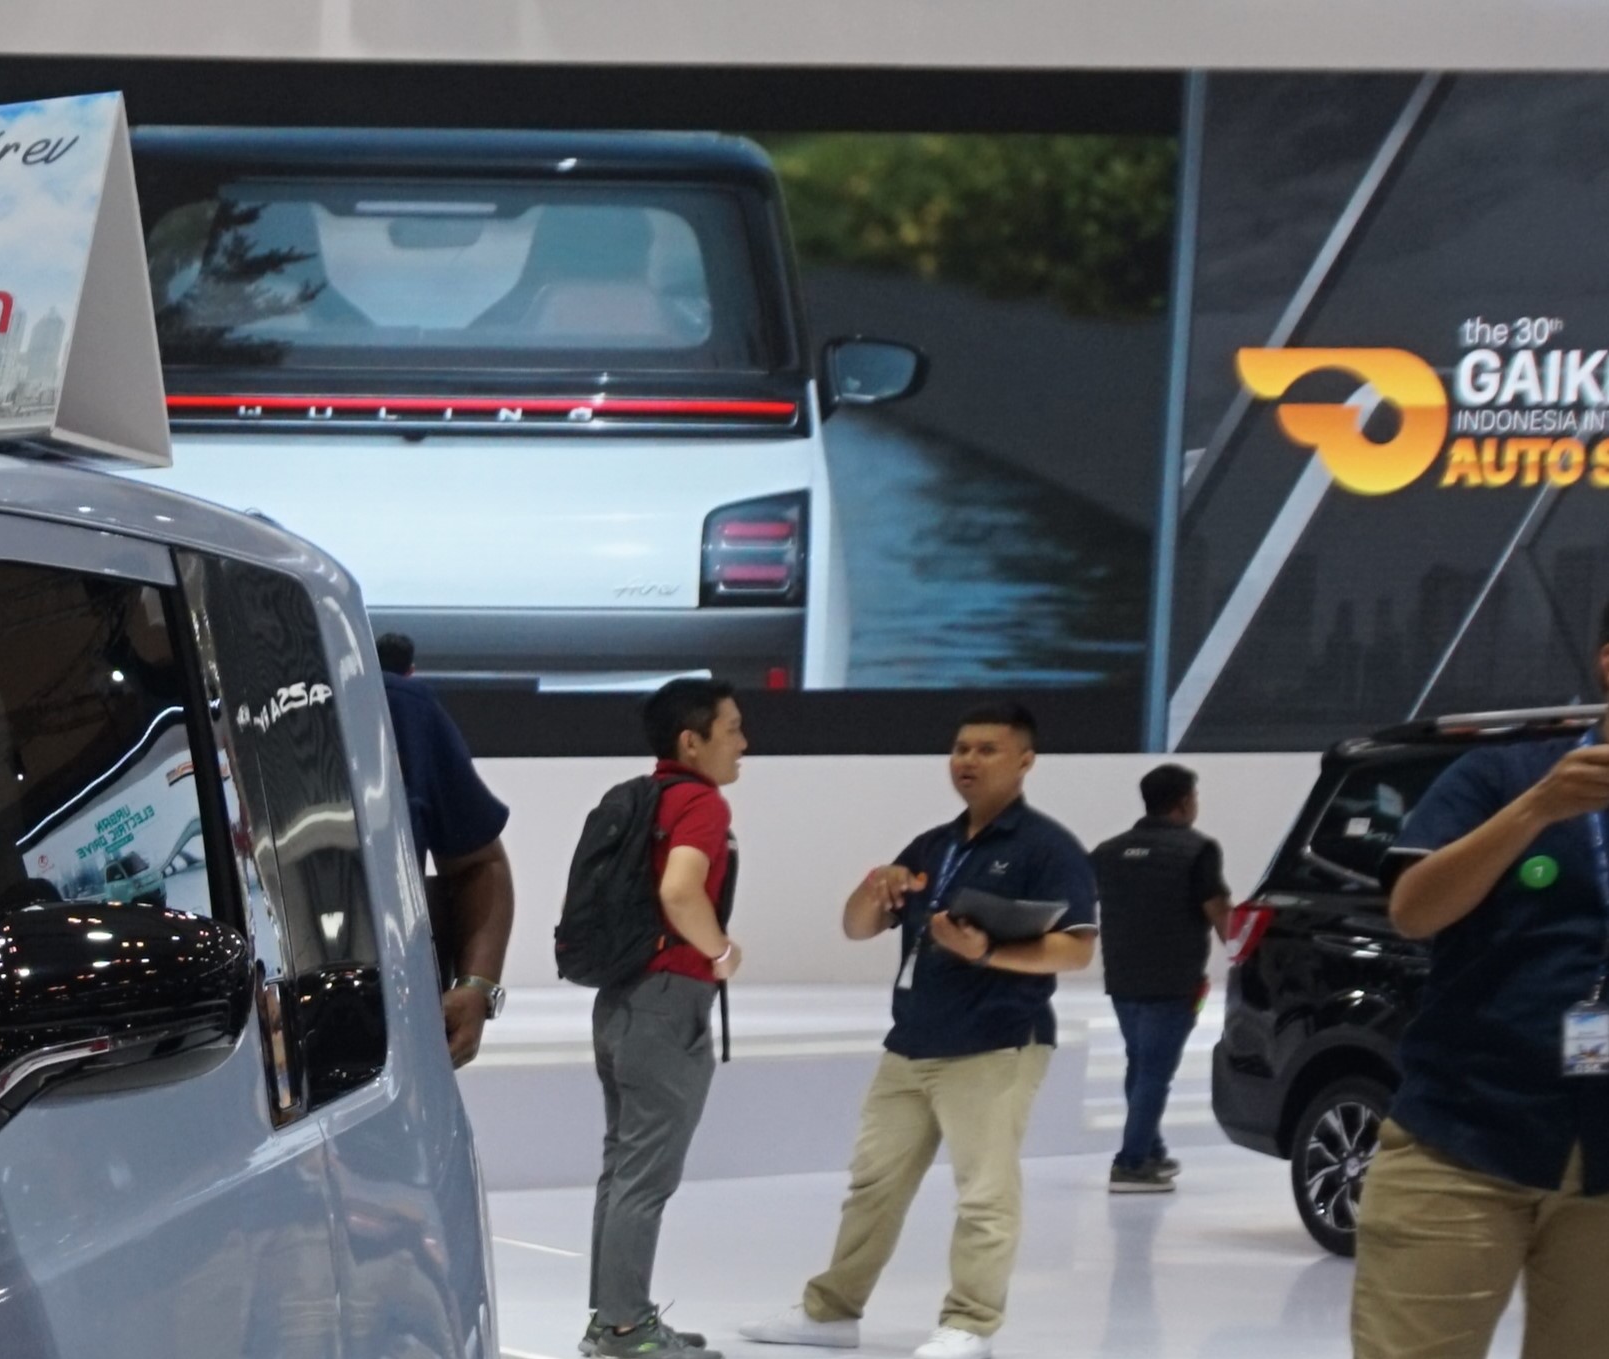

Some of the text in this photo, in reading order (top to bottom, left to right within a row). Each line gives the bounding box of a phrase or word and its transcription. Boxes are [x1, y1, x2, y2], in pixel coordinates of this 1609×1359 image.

[1462, 316, 1509, 346] the
[1456, 348, 1609, 405] GAIK
[1456, 408, 1578, 432] INDONESIA
[1439, 436, 1585, 487] AUTO
